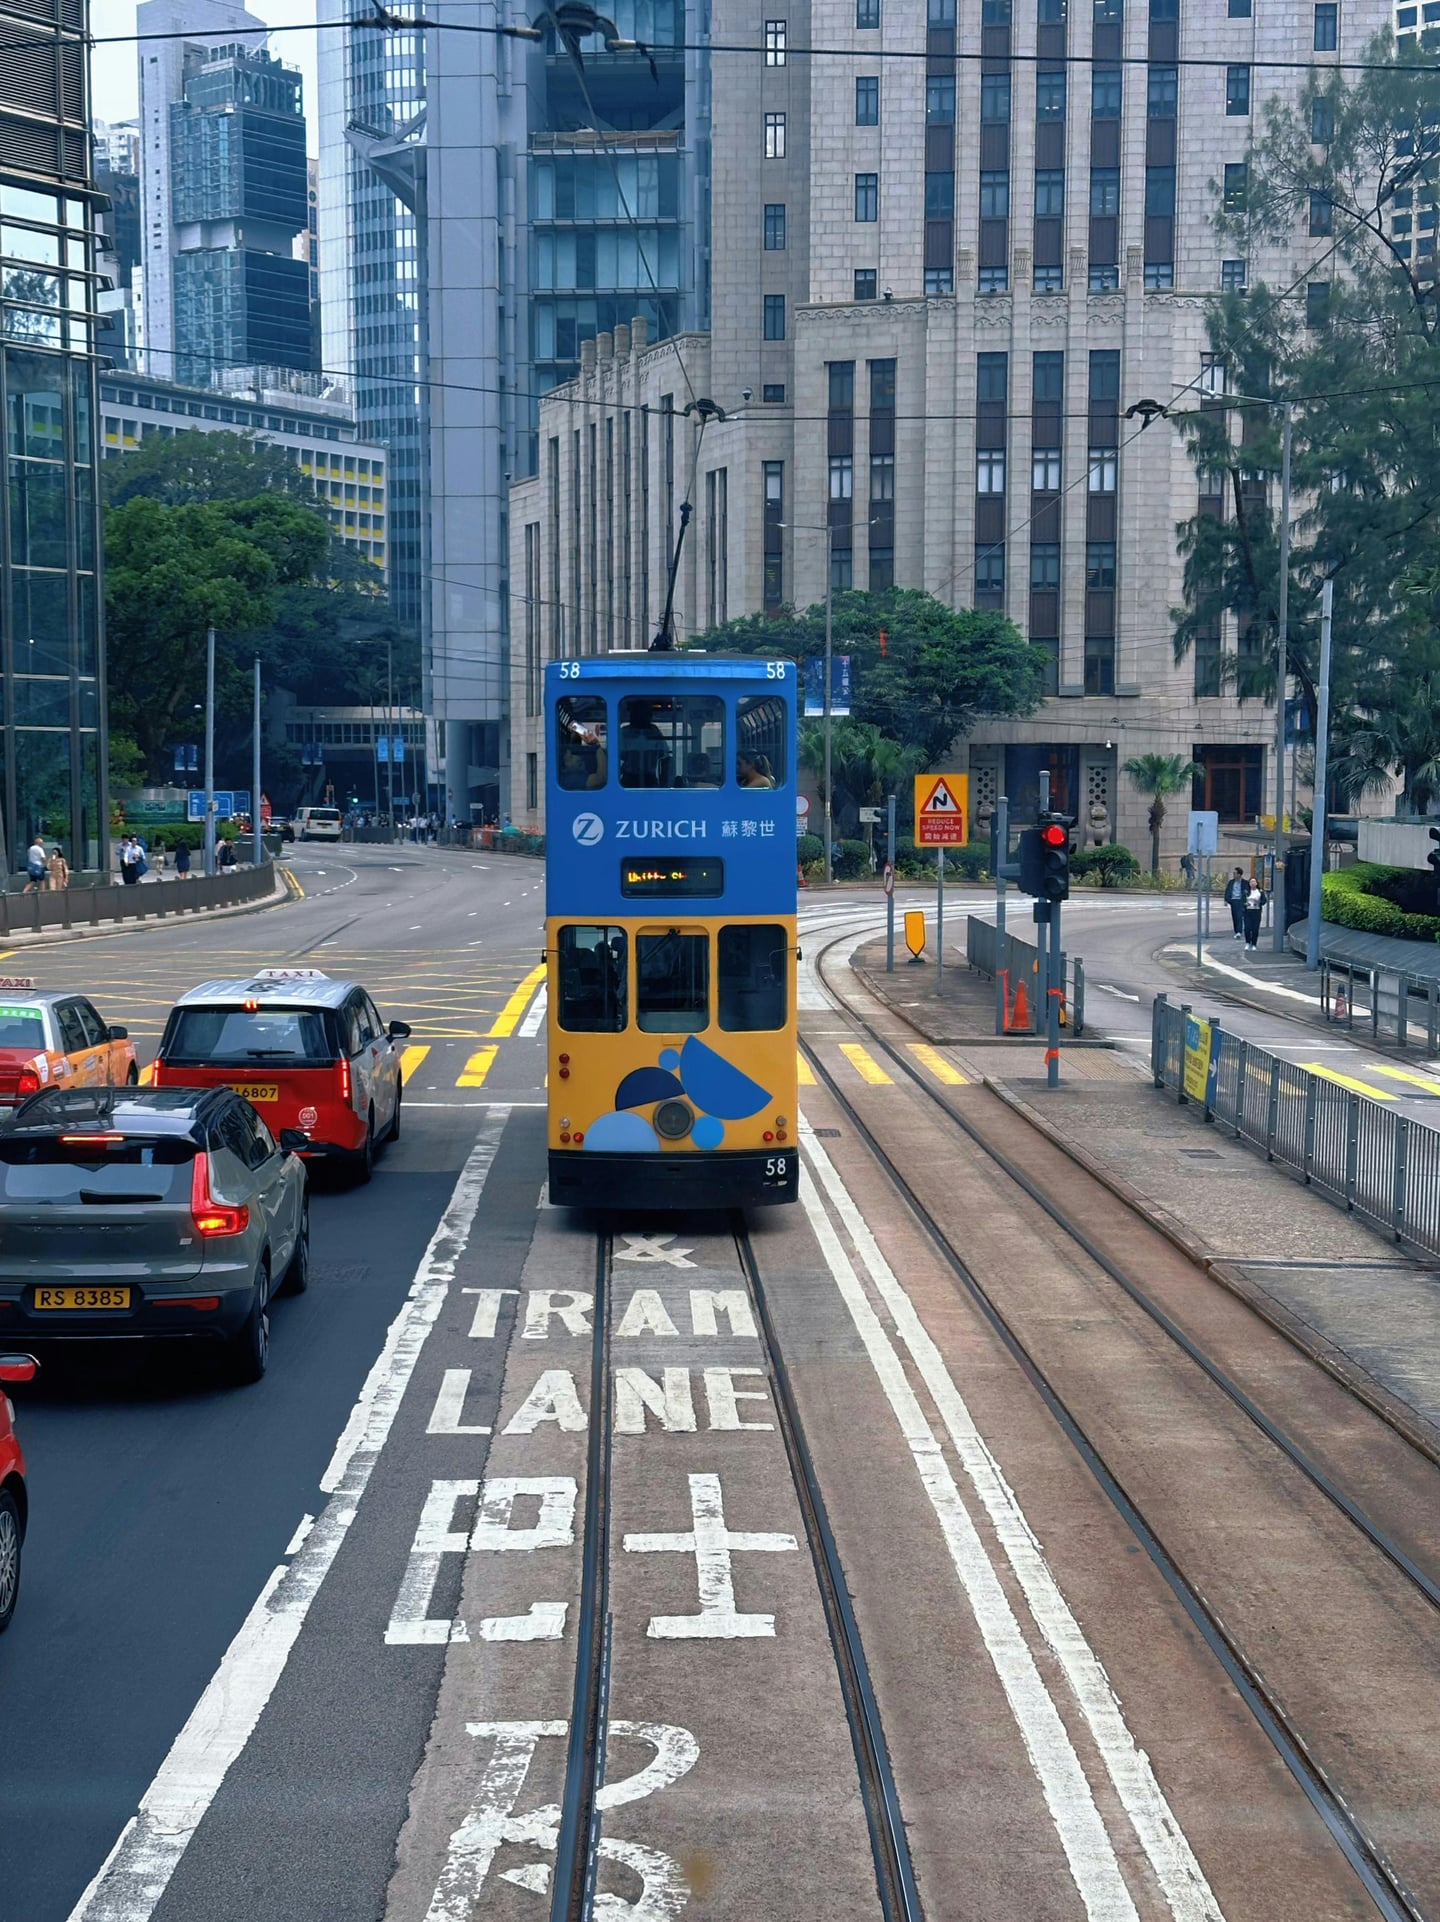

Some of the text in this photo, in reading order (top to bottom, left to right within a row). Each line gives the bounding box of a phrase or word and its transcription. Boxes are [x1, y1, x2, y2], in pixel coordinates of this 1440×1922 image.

[559, 662, 580, 679] 58
[766, 662, 786, 679] 58
[615, 820, 707, 838] ZURICH
[721, 819, 776, 838] 蘇黎世
[765, 1158, 786, 1176] 58
[40, 1290, 124, 1306] RS 8385
[462, 1287, 759, 1338] TRAM
[425, 1367, 775, 1435] LANE
[384, 1473, 799, 1645] 巴士
